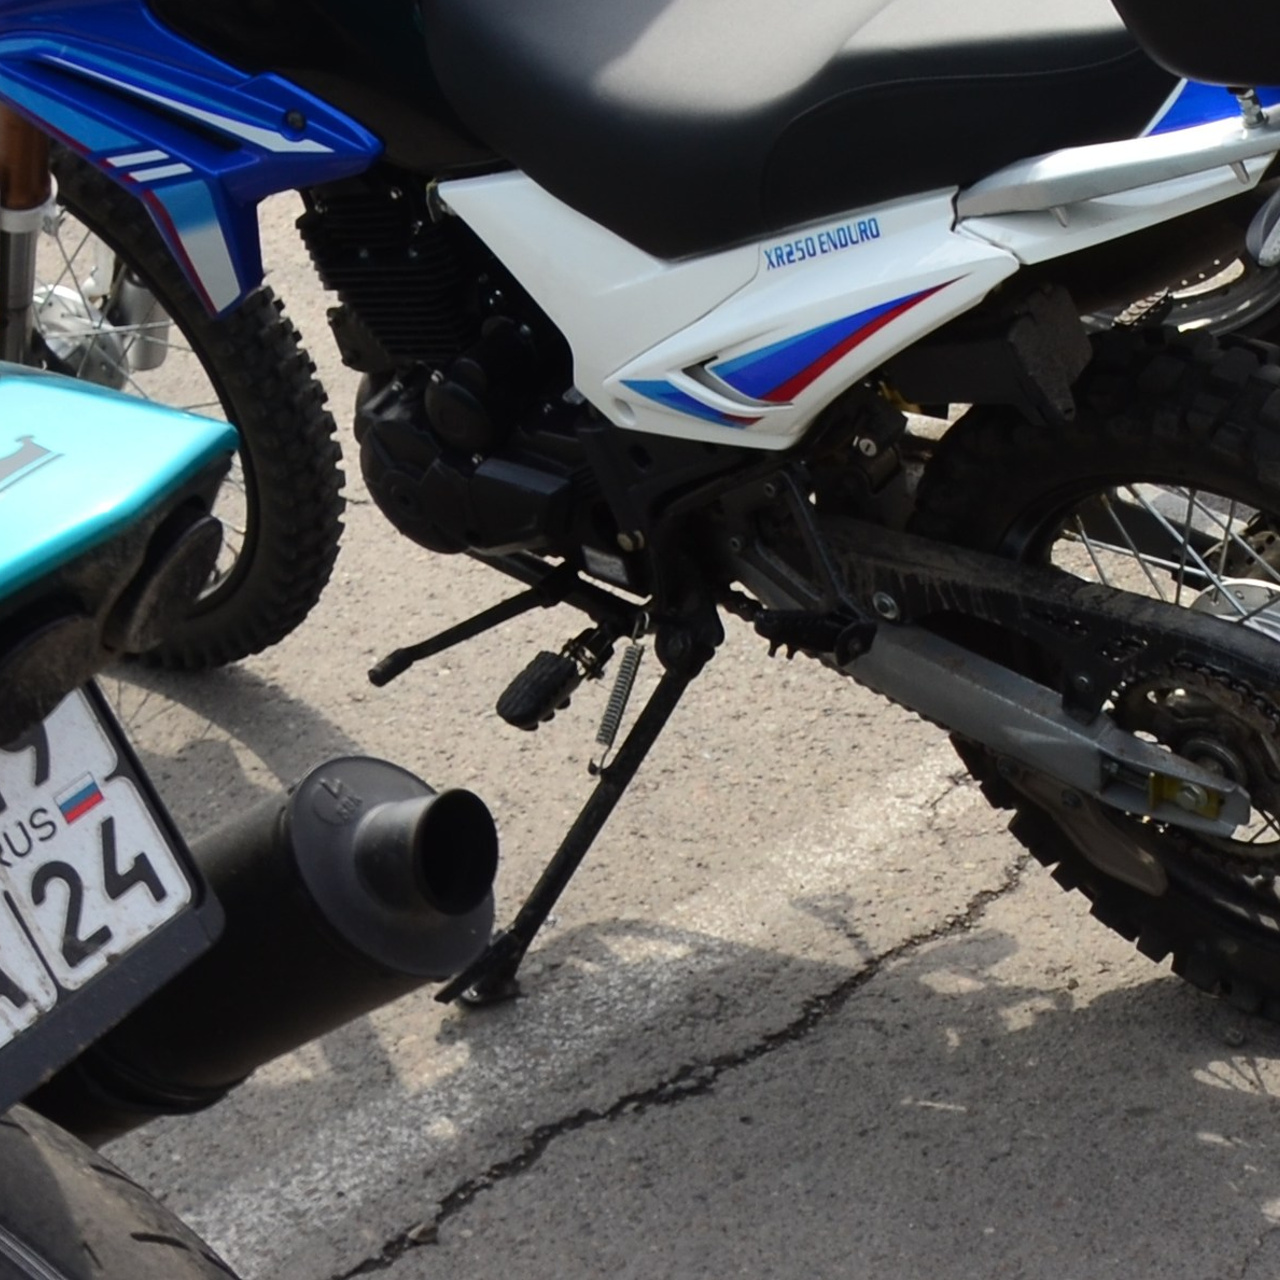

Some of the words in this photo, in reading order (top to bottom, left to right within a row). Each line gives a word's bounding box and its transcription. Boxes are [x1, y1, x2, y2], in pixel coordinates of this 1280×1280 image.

[764, 236, 817, 271] XR250
[817, 217, 880, 255] ENDURO
[31, 816, 167, 969] 24
